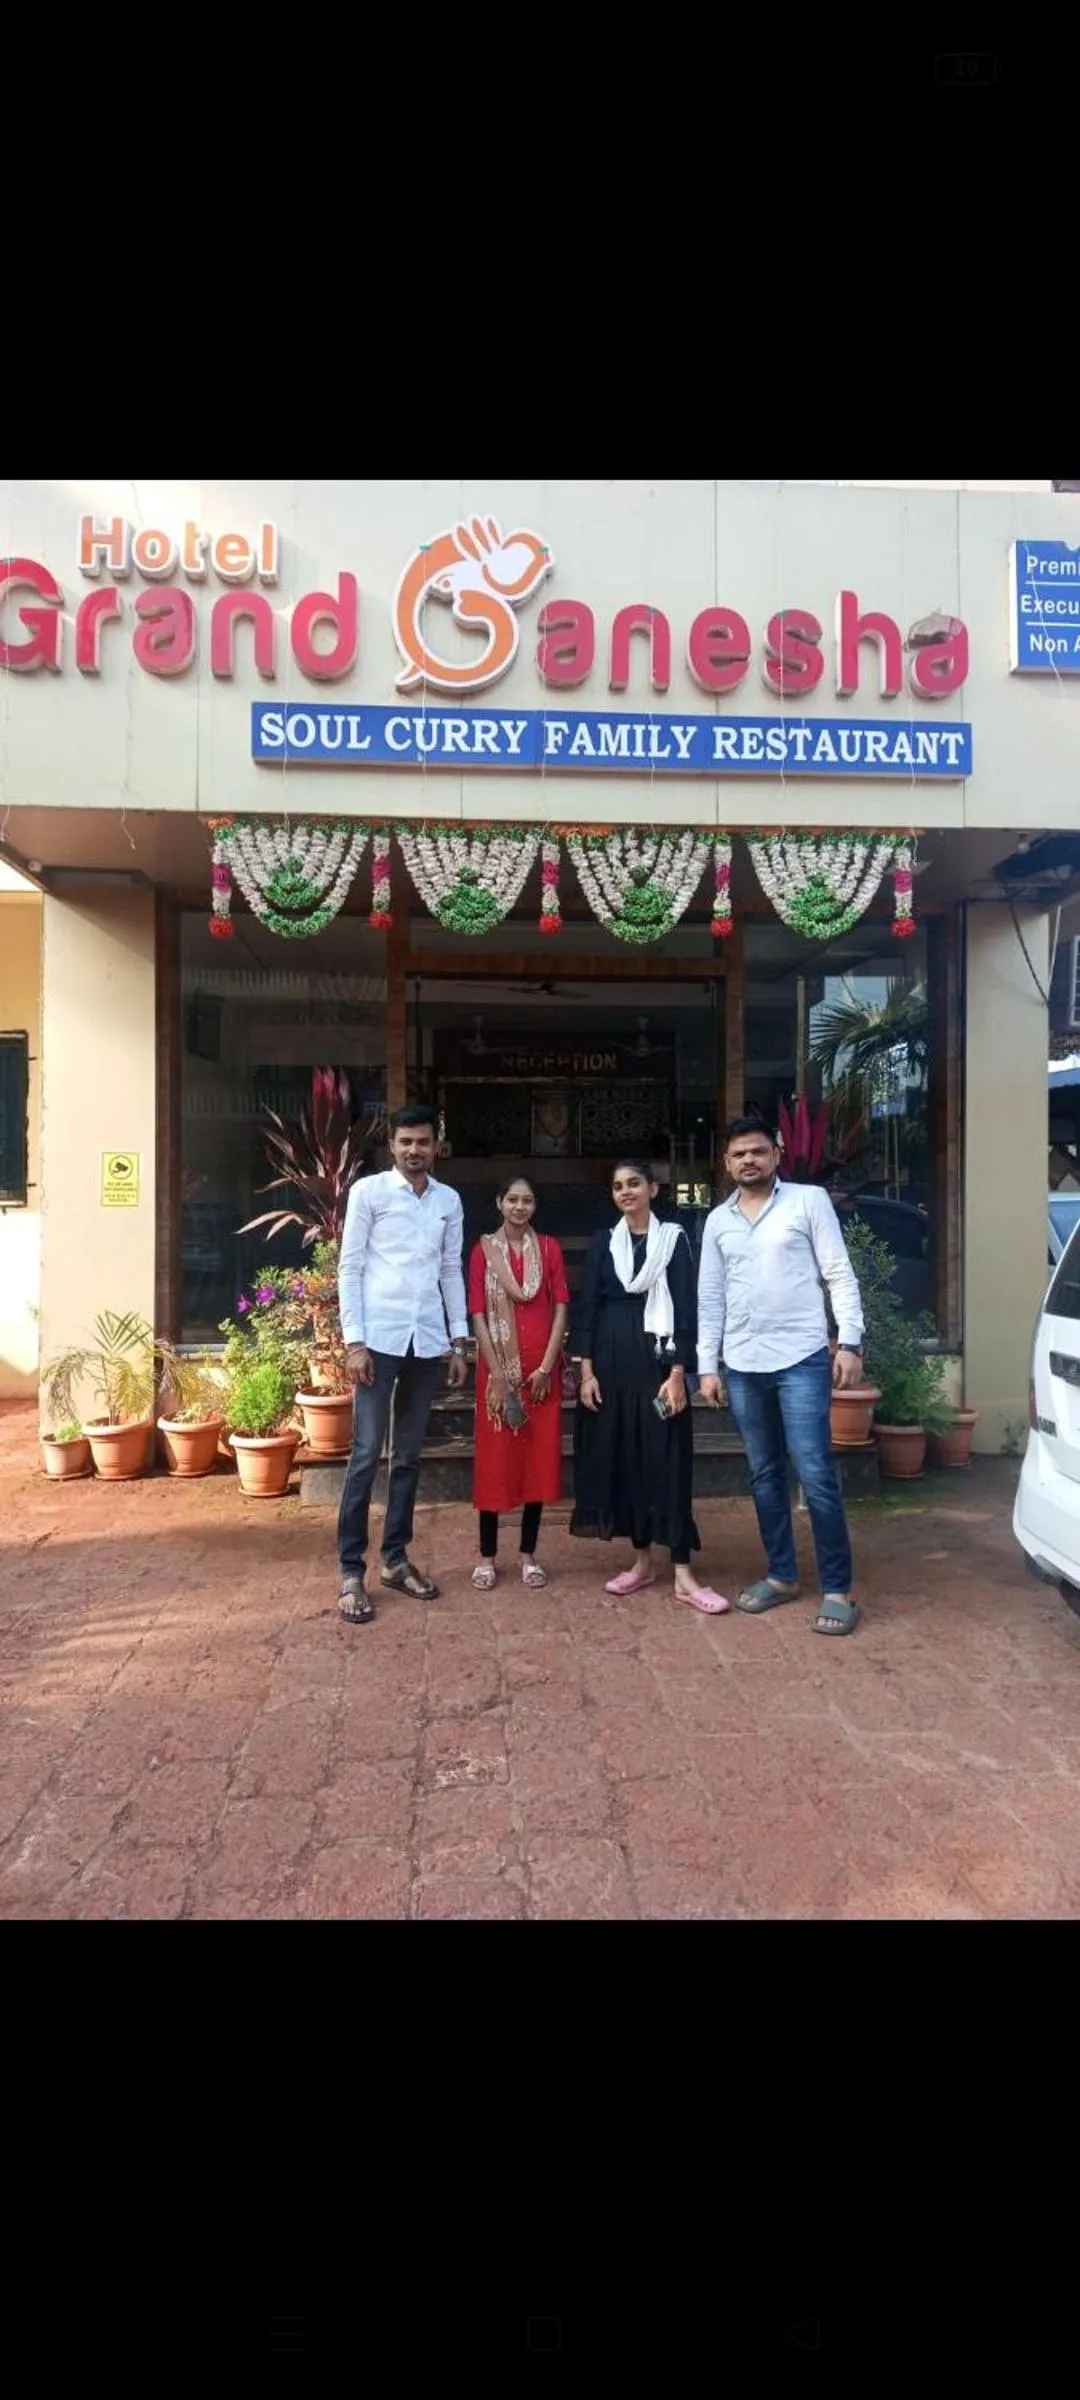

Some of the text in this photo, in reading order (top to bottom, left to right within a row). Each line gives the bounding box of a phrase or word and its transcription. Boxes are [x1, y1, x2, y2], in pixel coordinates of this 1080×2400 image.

[79, 514, 279, 584] Hotel
[0, 557, 359, 680] Grand
[1021, 594, 1080, 614] Execu
[1029, 633, 1068, 653] Non
[259, 712, 965, 765] SOUL CURRY FAMILY RESTAURANT
